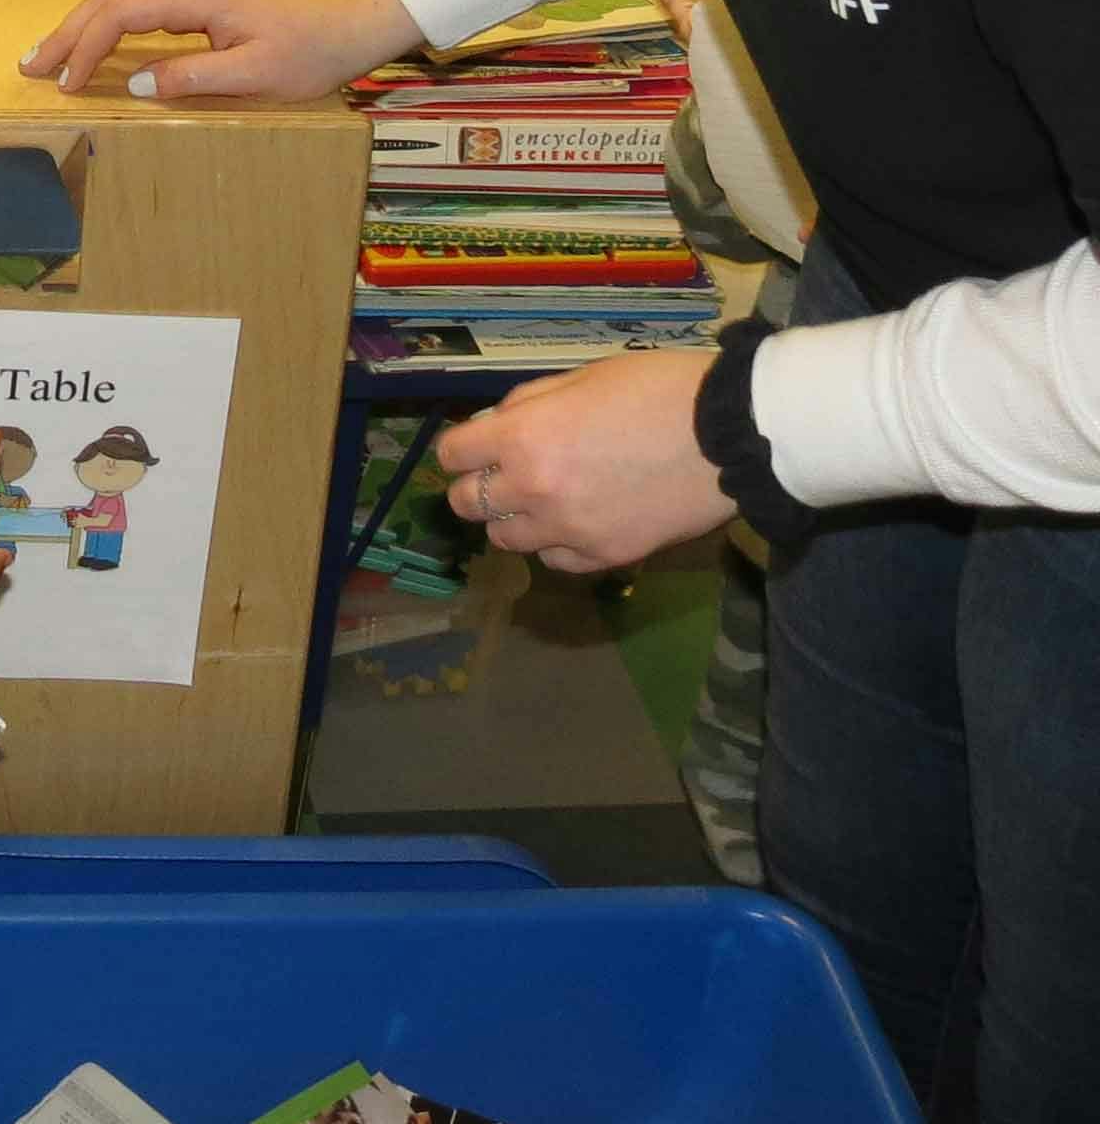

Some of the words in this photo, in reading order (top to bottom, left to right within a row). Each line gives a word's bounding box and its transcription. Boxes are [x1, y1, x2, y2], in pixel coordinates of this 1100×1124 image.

[515, 127, 662, 149] encyclopedia
[514, 150, 603, 162] SCIENCE
[0, 368, 117, 404] Table
